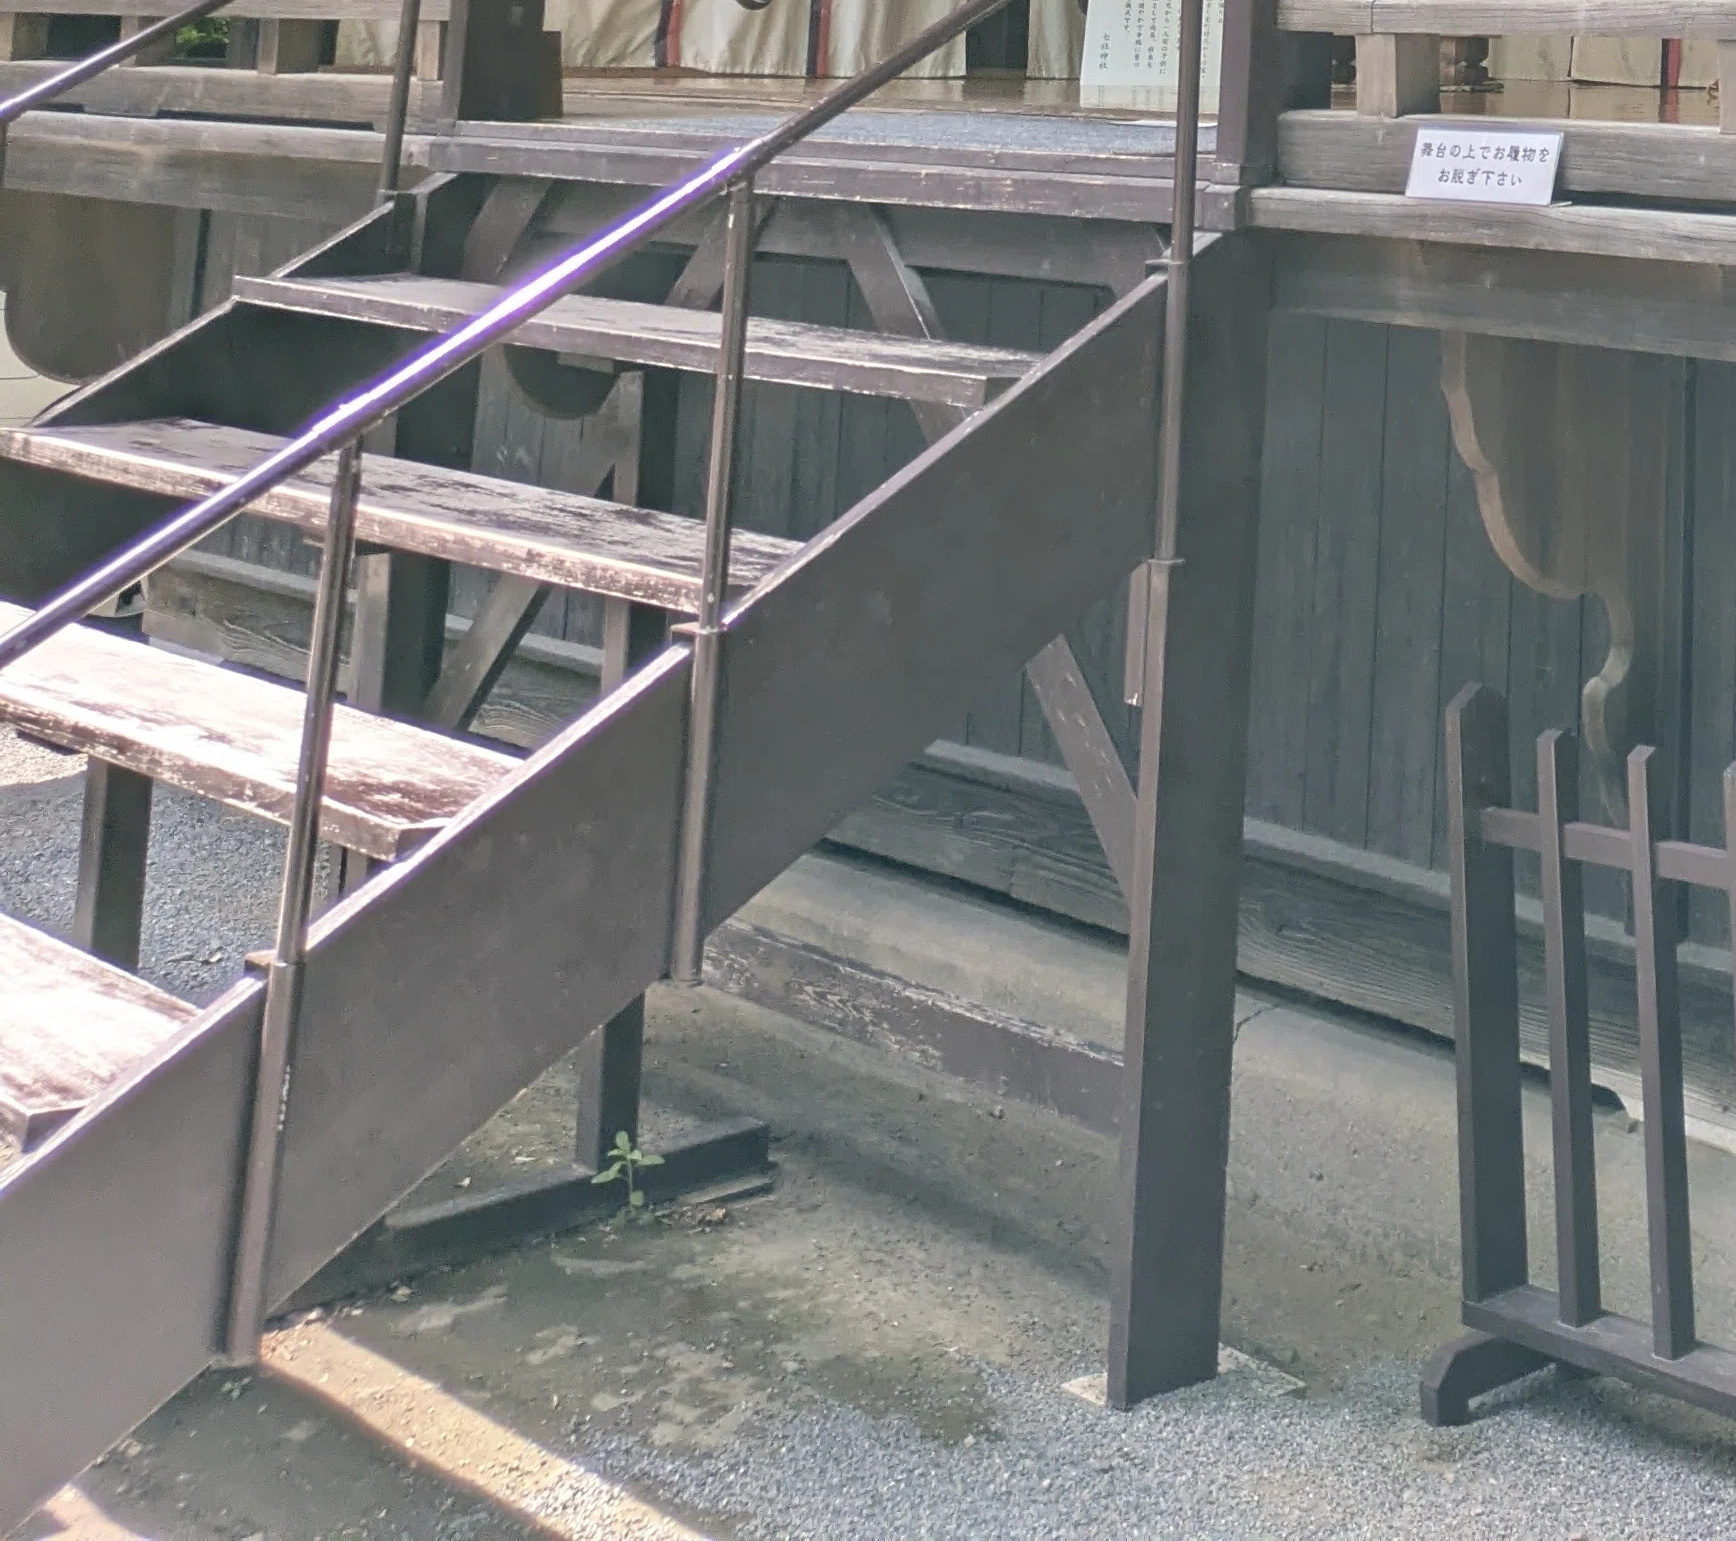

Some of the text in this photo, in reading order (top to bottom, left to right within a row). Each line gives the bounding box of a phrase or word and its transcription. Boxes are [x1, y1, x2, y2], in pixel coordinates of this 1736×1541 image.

[1098, 32, 1111, 71] 七社神社
[1420, 141, 1550, 163] 舞台の上でお履物を
[1437, 167, 1523, 187] お脱ぎ下さい
